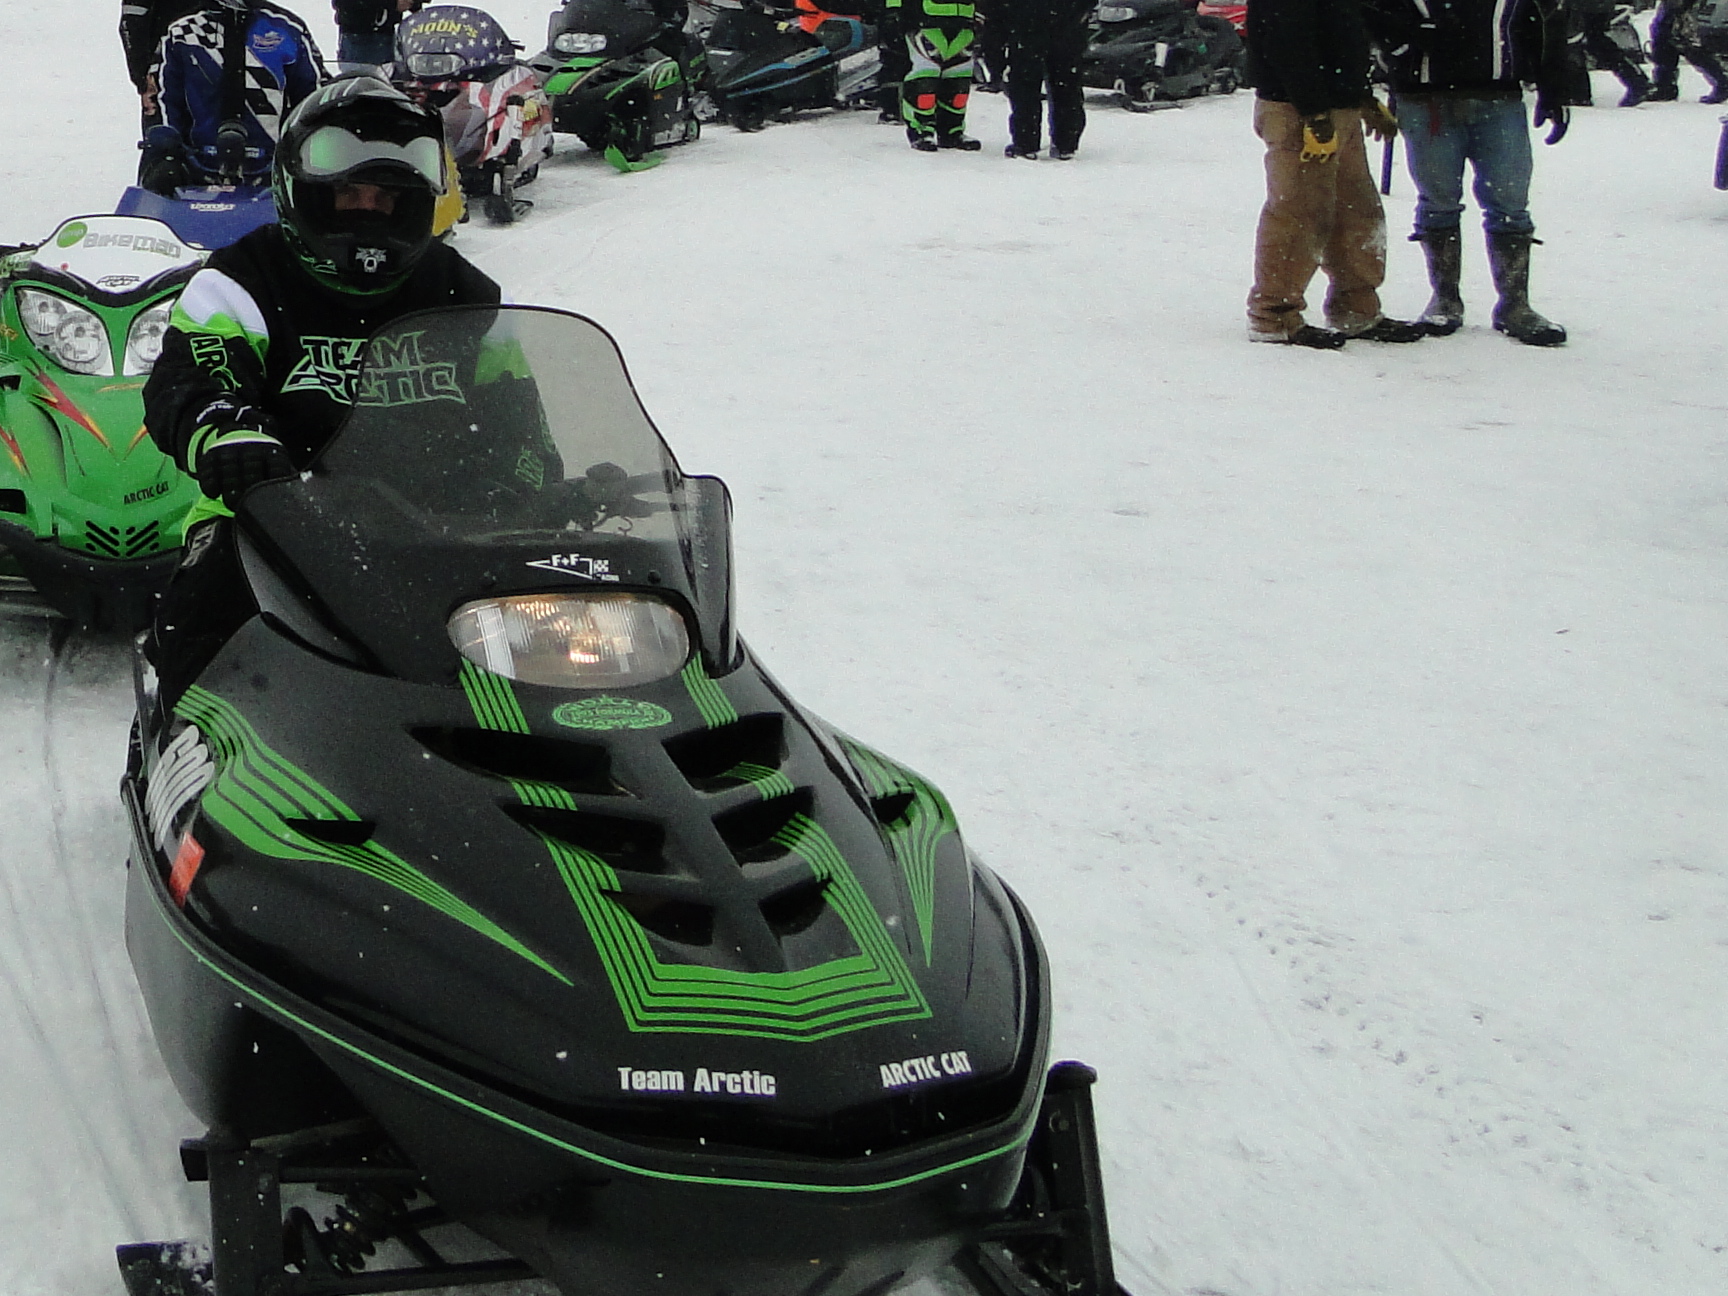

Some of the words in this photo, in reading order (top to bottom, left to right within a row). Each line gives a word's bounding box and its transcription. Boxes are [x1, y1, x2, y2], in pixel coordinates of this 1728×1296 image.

[299, 331, 427, 371] TEAM
[280, 356, 467, 407] ARCTIC
[124, 486, 155, 505] ARCTIC
[156, 481, 169, 495] CAT
[618, 1067, 685, 1091] Team
[693, 1067, 777, 1096] Arctic
[879, 1055, 941, 1088] ARCTIC
[940, 1050, 972, 1075] CAT
